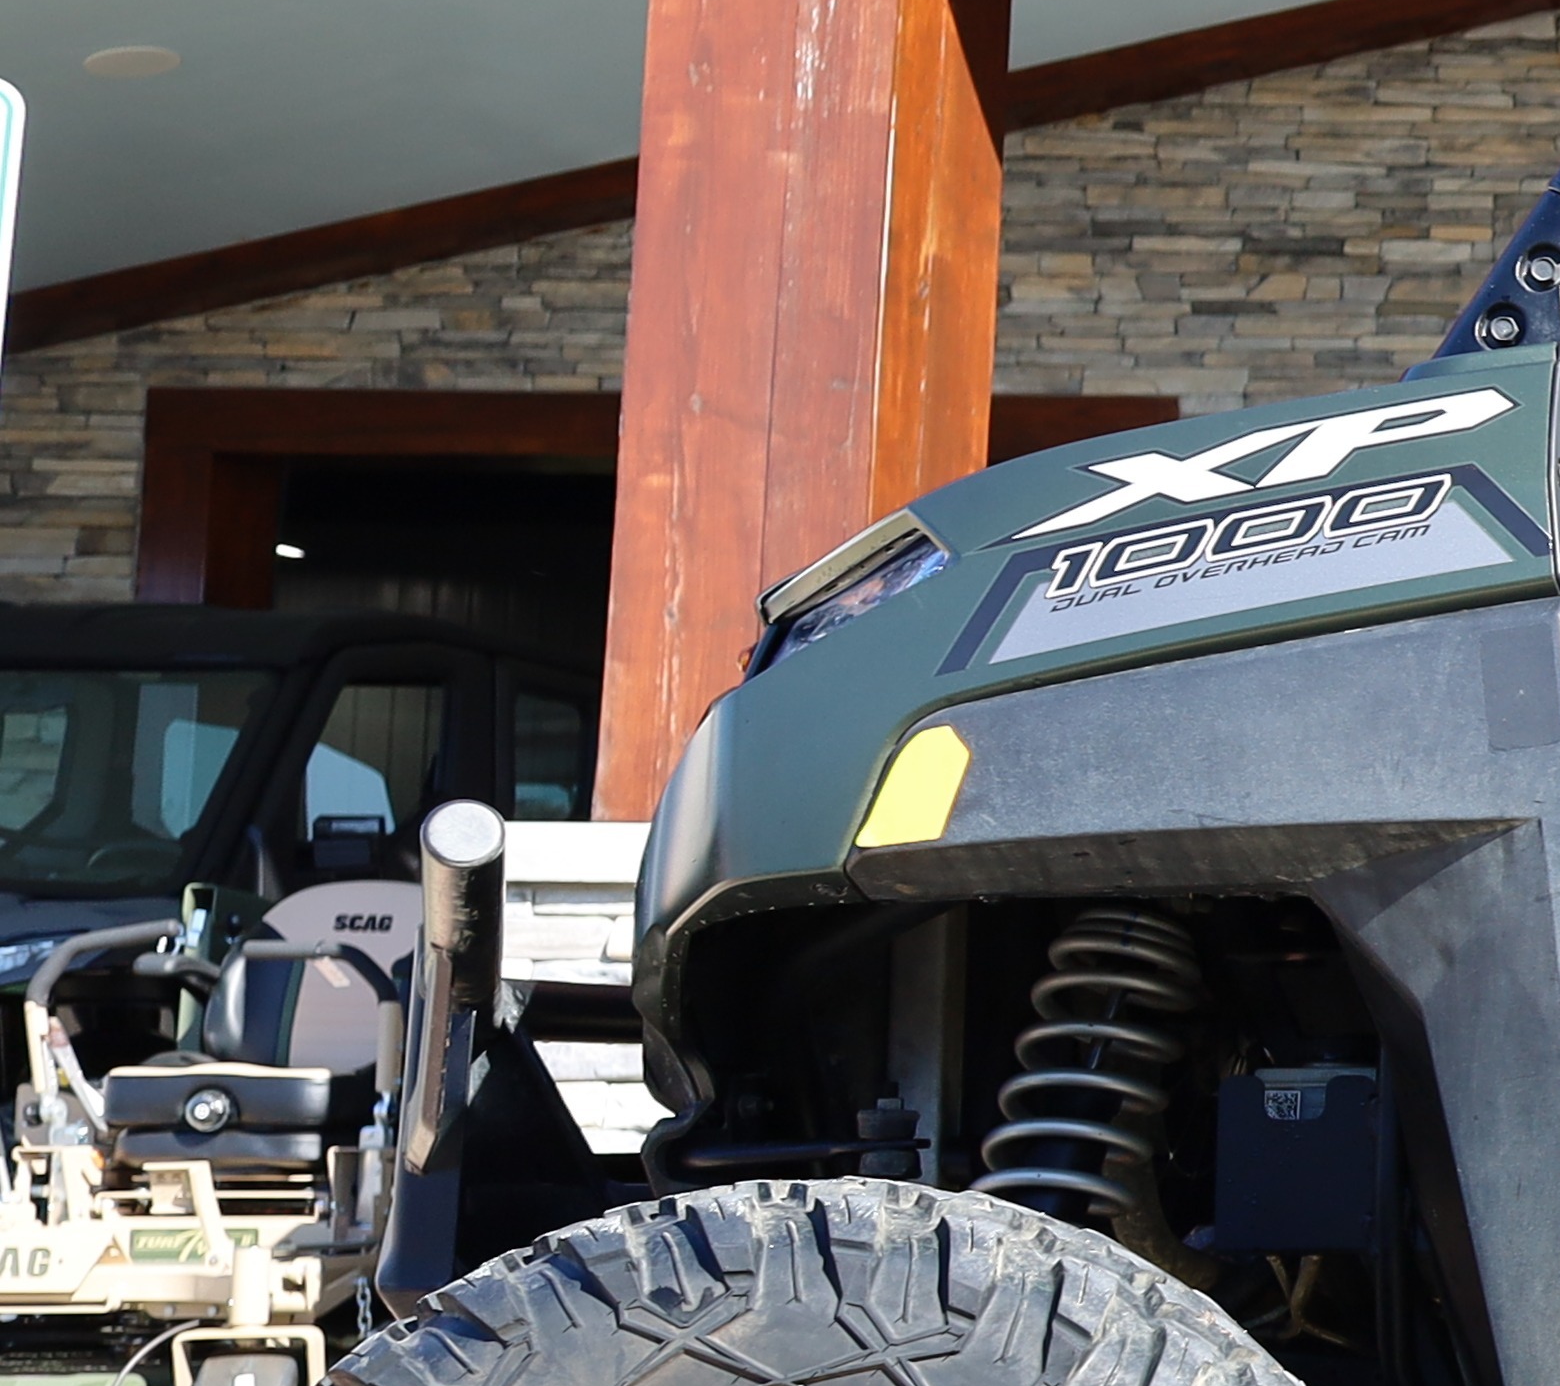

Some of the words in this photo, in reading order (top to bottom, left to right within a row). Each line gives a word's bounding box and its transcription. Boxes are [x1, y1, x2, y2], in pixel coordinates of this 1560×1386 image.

[1010, 386, 1520, 541] XP
[1044, 472, 1453, 599] 1000
[1050, 582, 1142, 612] DUAL
[1153, 540, 1345, 590] OVERHEAD
[1352, 523, 1432, 549] CAM
[333, 914, 394, 932] SCAG
